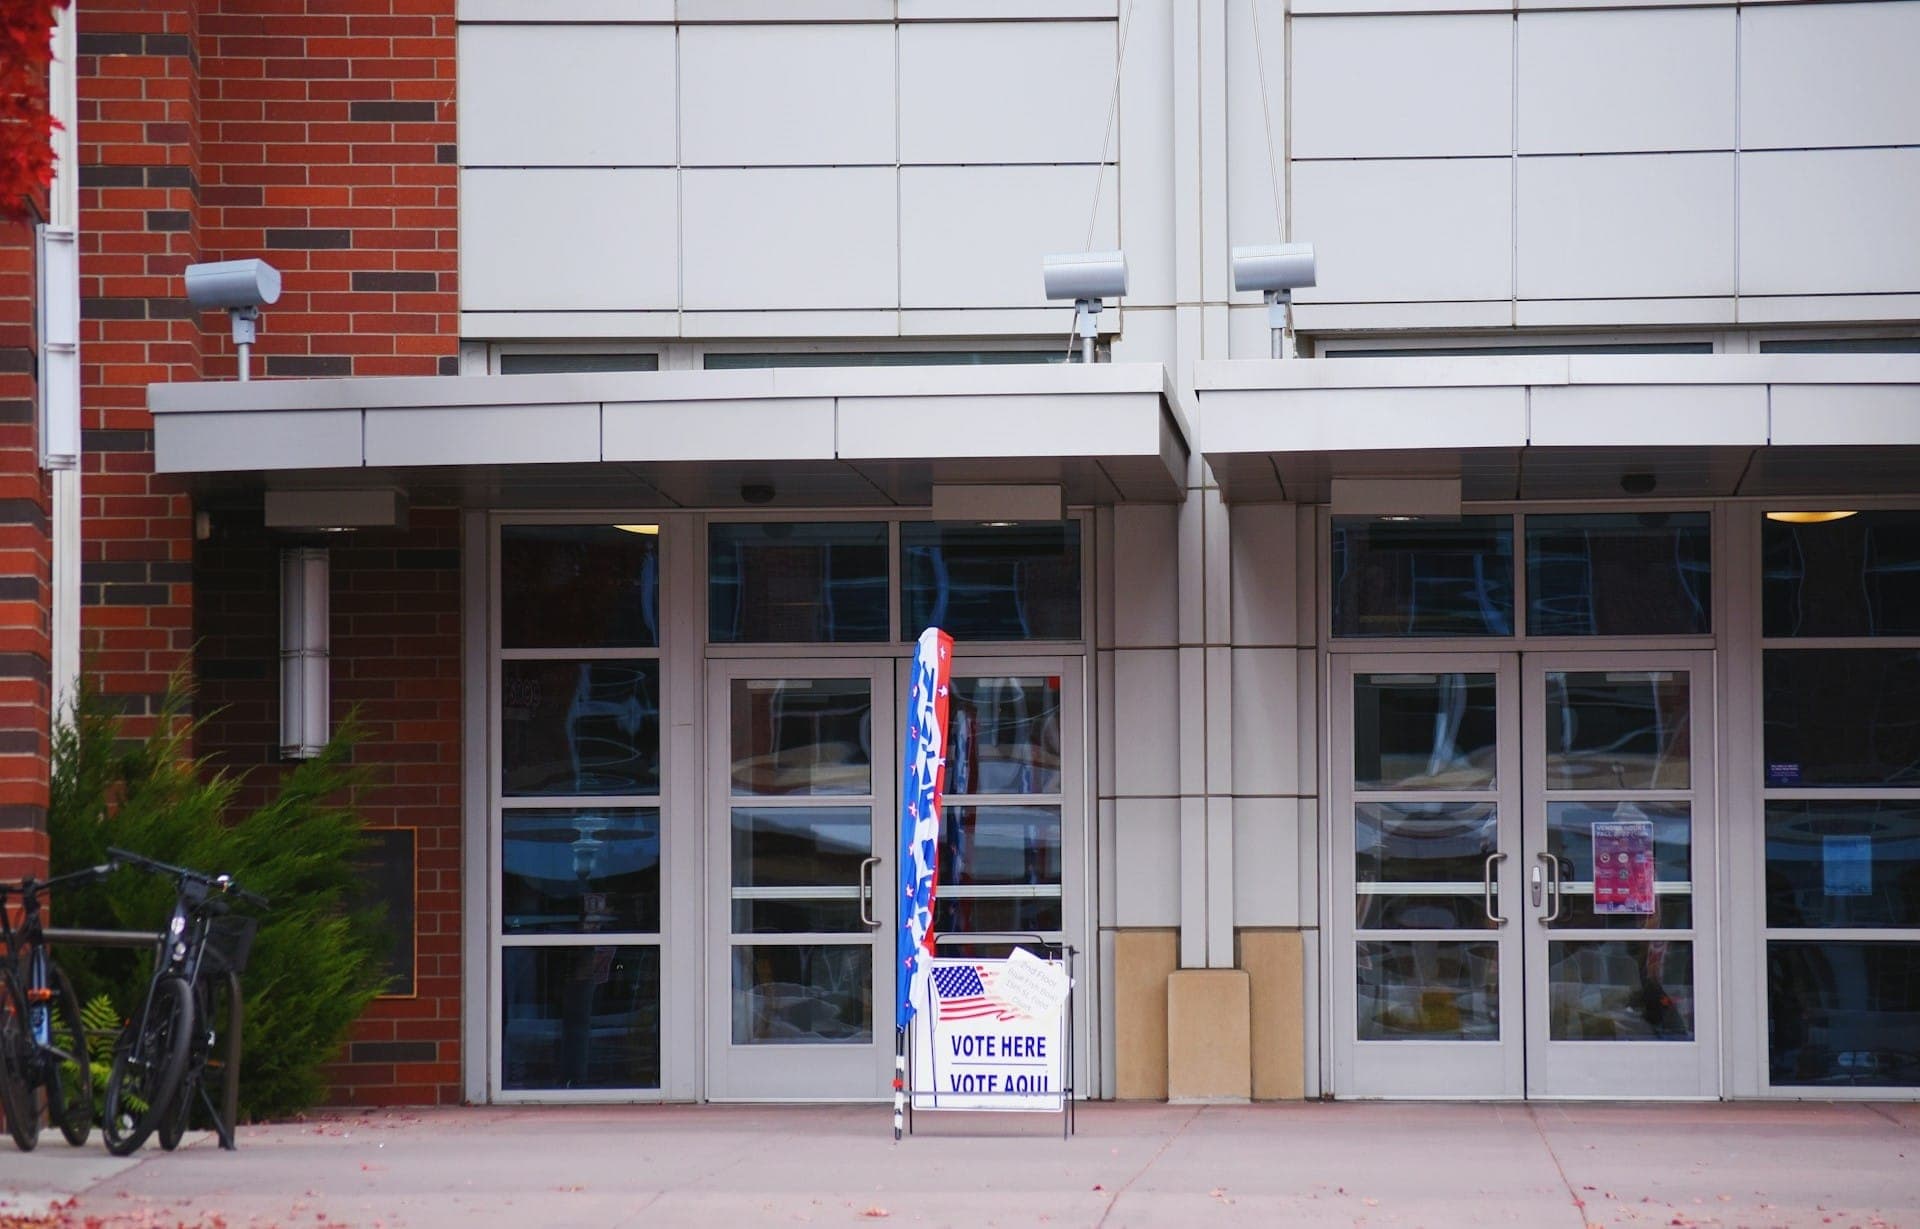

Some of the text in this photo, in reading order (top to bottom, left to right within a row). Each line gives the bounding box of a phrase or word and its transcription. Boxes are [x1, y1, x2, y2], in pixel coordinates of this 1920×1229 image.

[951, 1034, 1046, 1058] VOTE HERE
[950, 1074, 998, 1095] VOTE
